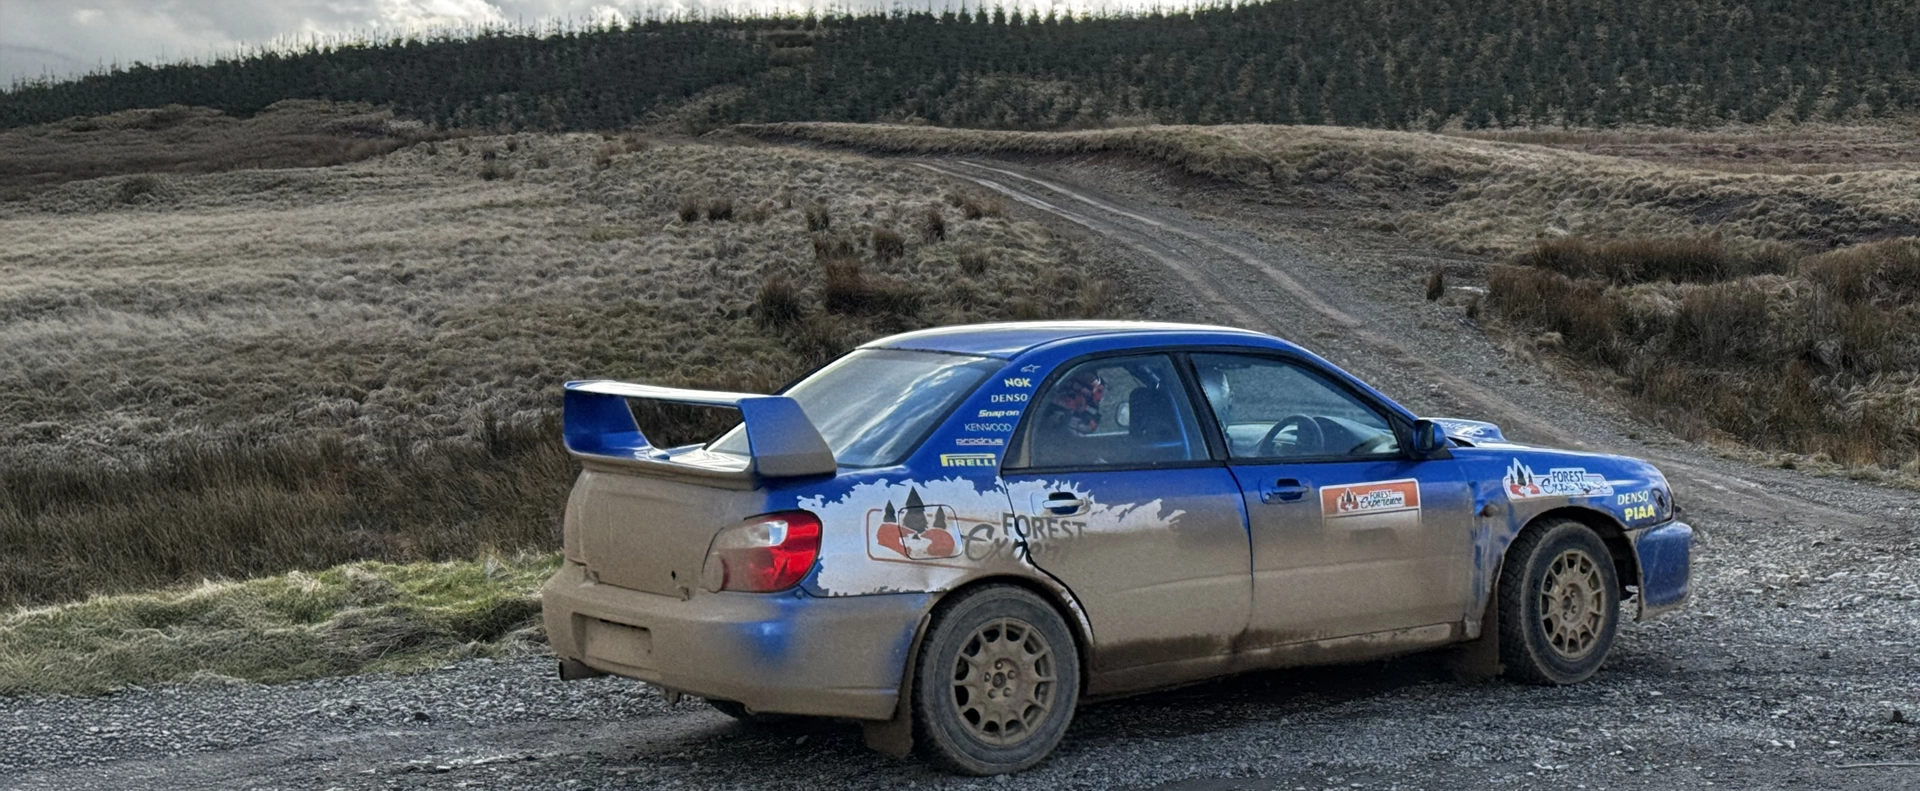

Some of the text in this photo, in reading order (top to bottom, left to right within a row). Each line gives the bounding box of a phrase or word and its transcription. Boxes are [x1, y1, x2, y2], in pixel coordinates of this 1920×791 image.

[1004, 378, 1032, 388] NGK
[991, 393, 1028, 403] DENSO
[978, 409, 1020, 418] Snap-on
[964, 423, 1012, 432] KENWOOD
[940, 453, 997, 467] PIRELLI
[1551, 470, 1584, 483] FOREST
[1369, 490, 1391, 499] FOREST
[1617, 490, 1649, 506] DENSO
[1624, 504, 1656, 522] PIAA
[1002, 512, 1087, 540] FOREST
